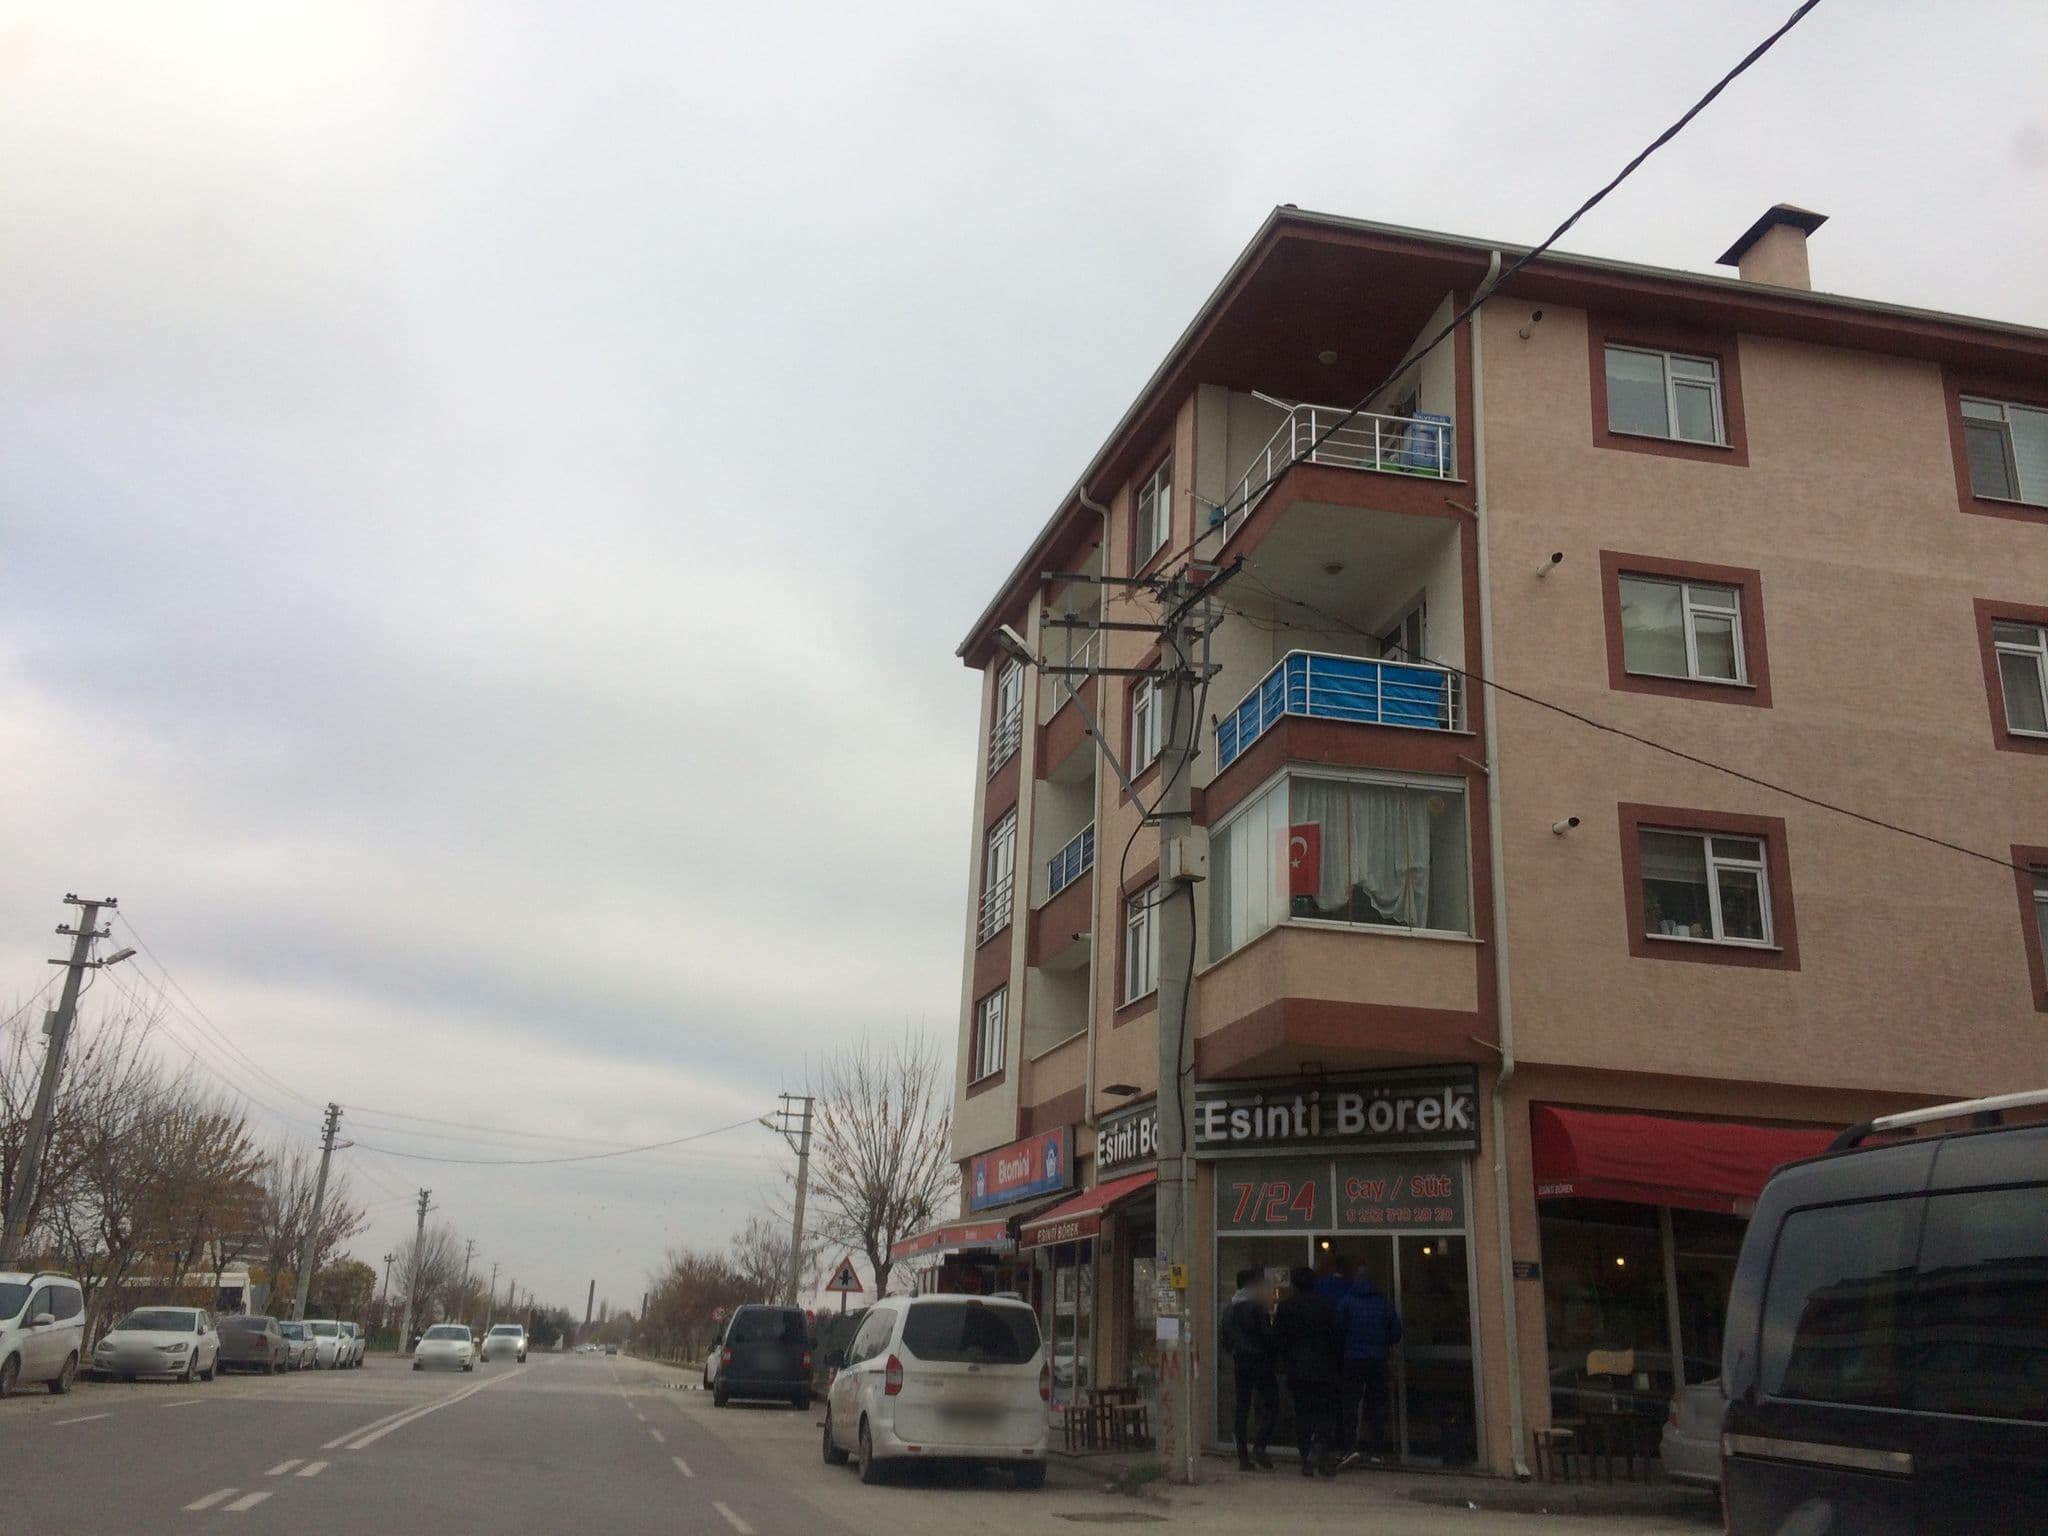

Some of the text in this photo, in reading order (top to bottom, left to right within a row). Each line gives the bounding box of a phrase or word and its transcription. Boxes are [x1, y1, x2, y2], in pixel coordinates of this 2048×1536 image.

[1204, 1090, 1320, 1141] Esinti
[1336, 1087, 1469, 1134] Börek
[1097, 1117, 1137, 1166] Esinti
[998, 1147, 1030, 1184] Ekomini
[1410, 1174, 1451, 1198] Süt
[1232, 1178, 1316, 1223] 7/24
